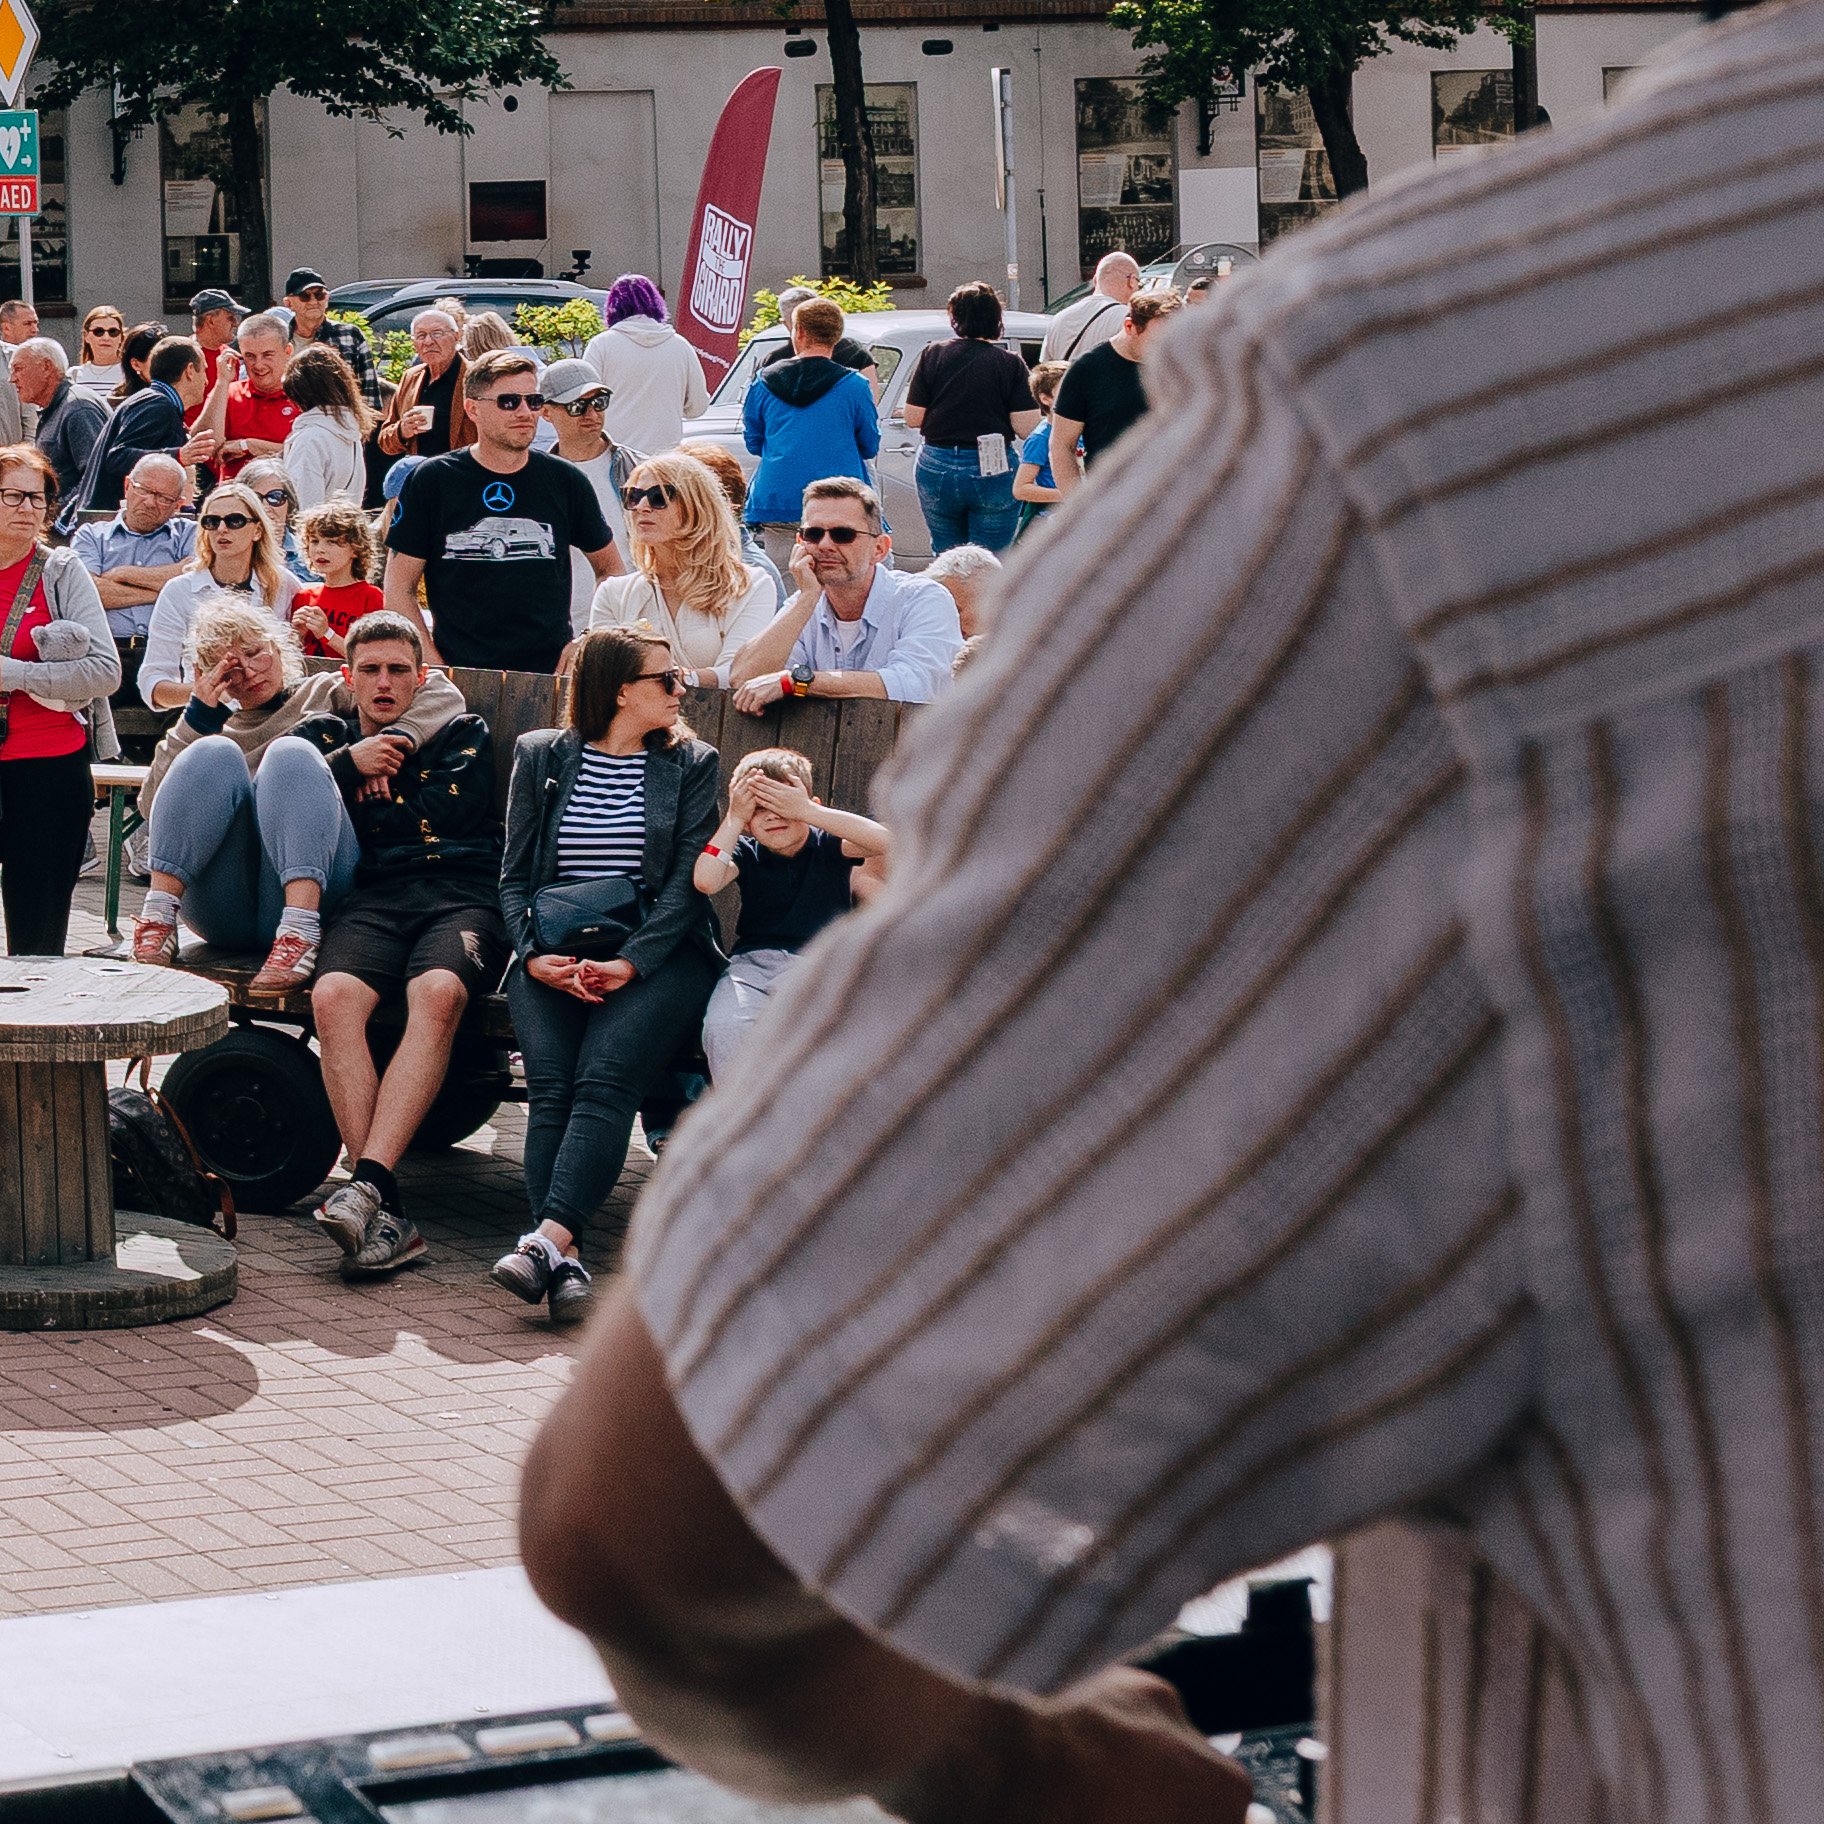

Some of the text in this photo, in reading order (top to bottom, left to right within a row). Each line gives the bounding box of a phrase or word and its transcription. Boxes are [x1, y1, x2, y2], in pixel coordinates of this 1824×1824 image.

[0, 184, 32, 209] AED
[704, 212, 747, 260] RALLY
[693, 261, 741, 325] GIRARD
